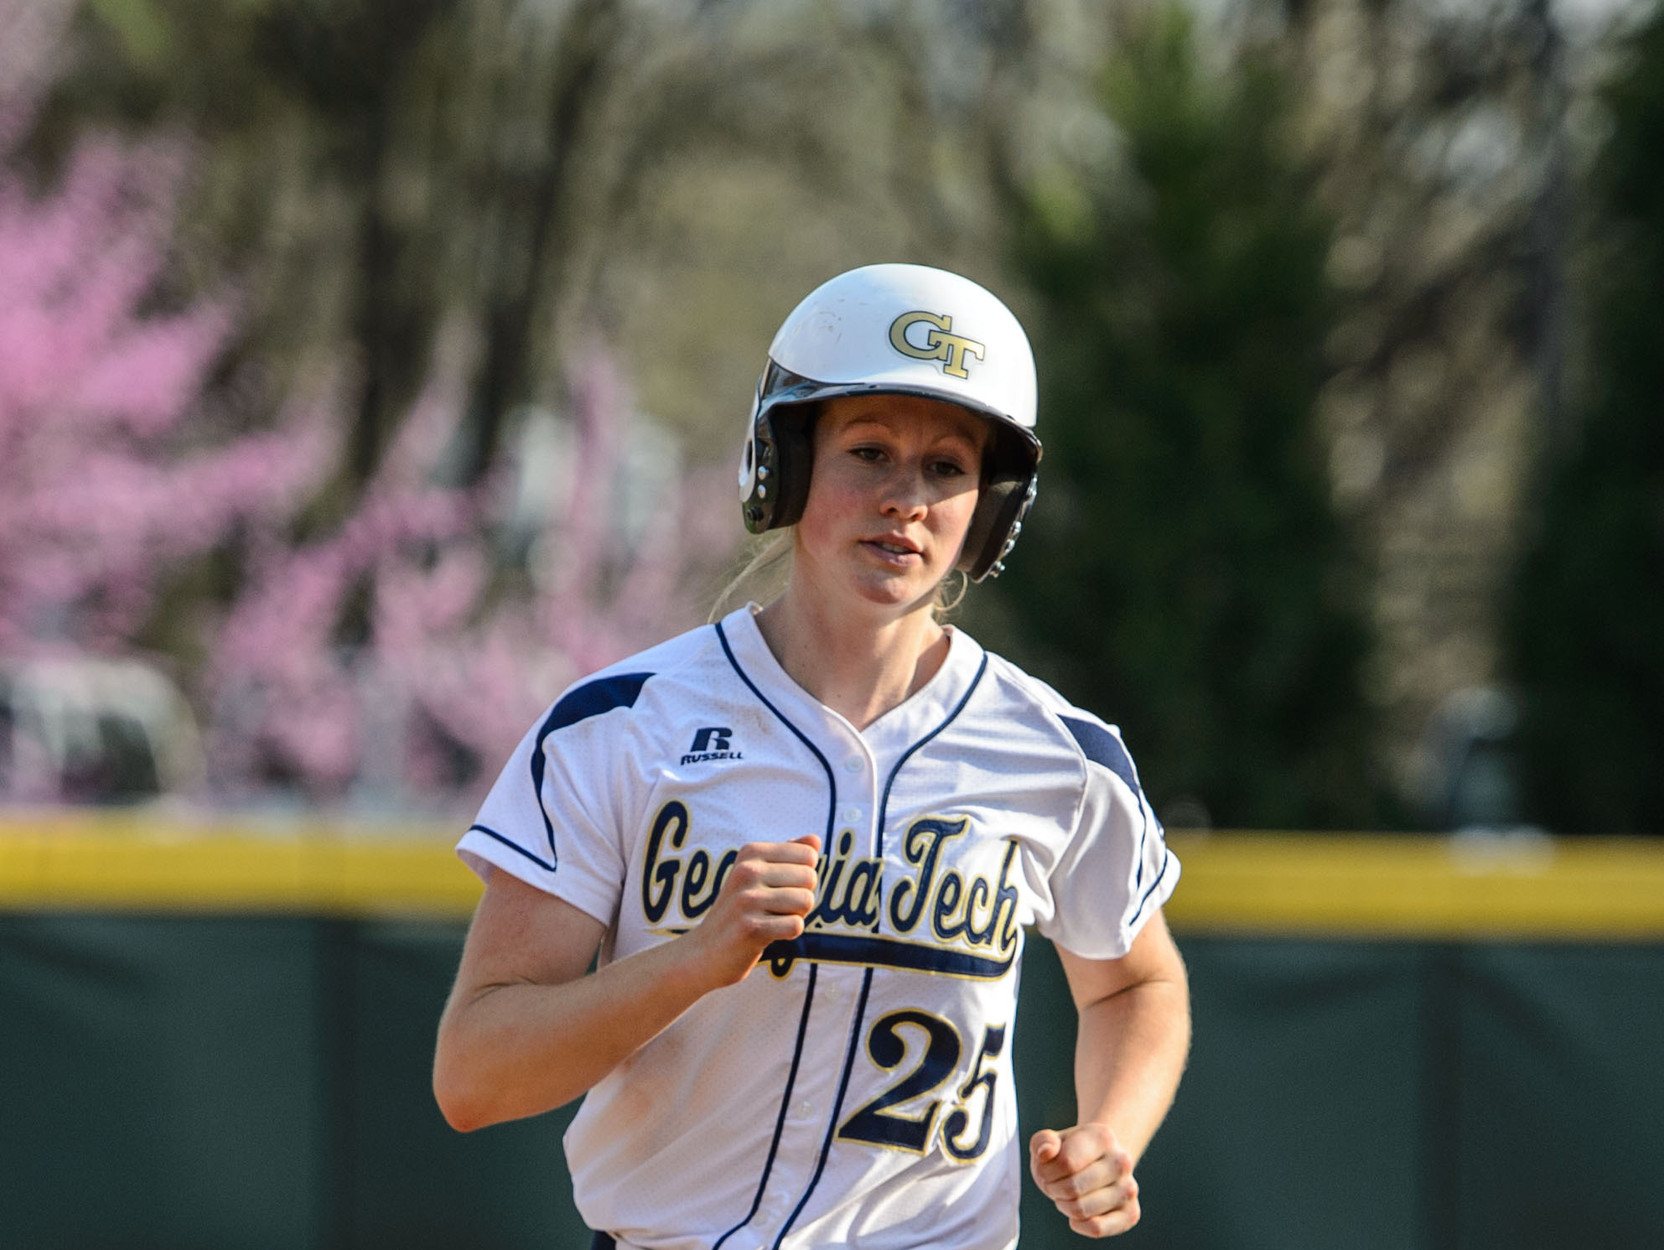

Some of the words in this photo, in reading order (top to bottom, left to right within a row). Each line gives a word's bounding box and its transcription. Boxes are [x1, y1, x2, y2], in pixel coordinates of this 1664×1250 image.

[889, 311, 986, 380] GT
[680, 751, 743, 766] RUSSELL
[690, 727, 733, 752] R
[642, 799, 882, 979] Geia
[889, 814, 1019, 955] Tech
[834, 1008, 1006, 1163] 25
